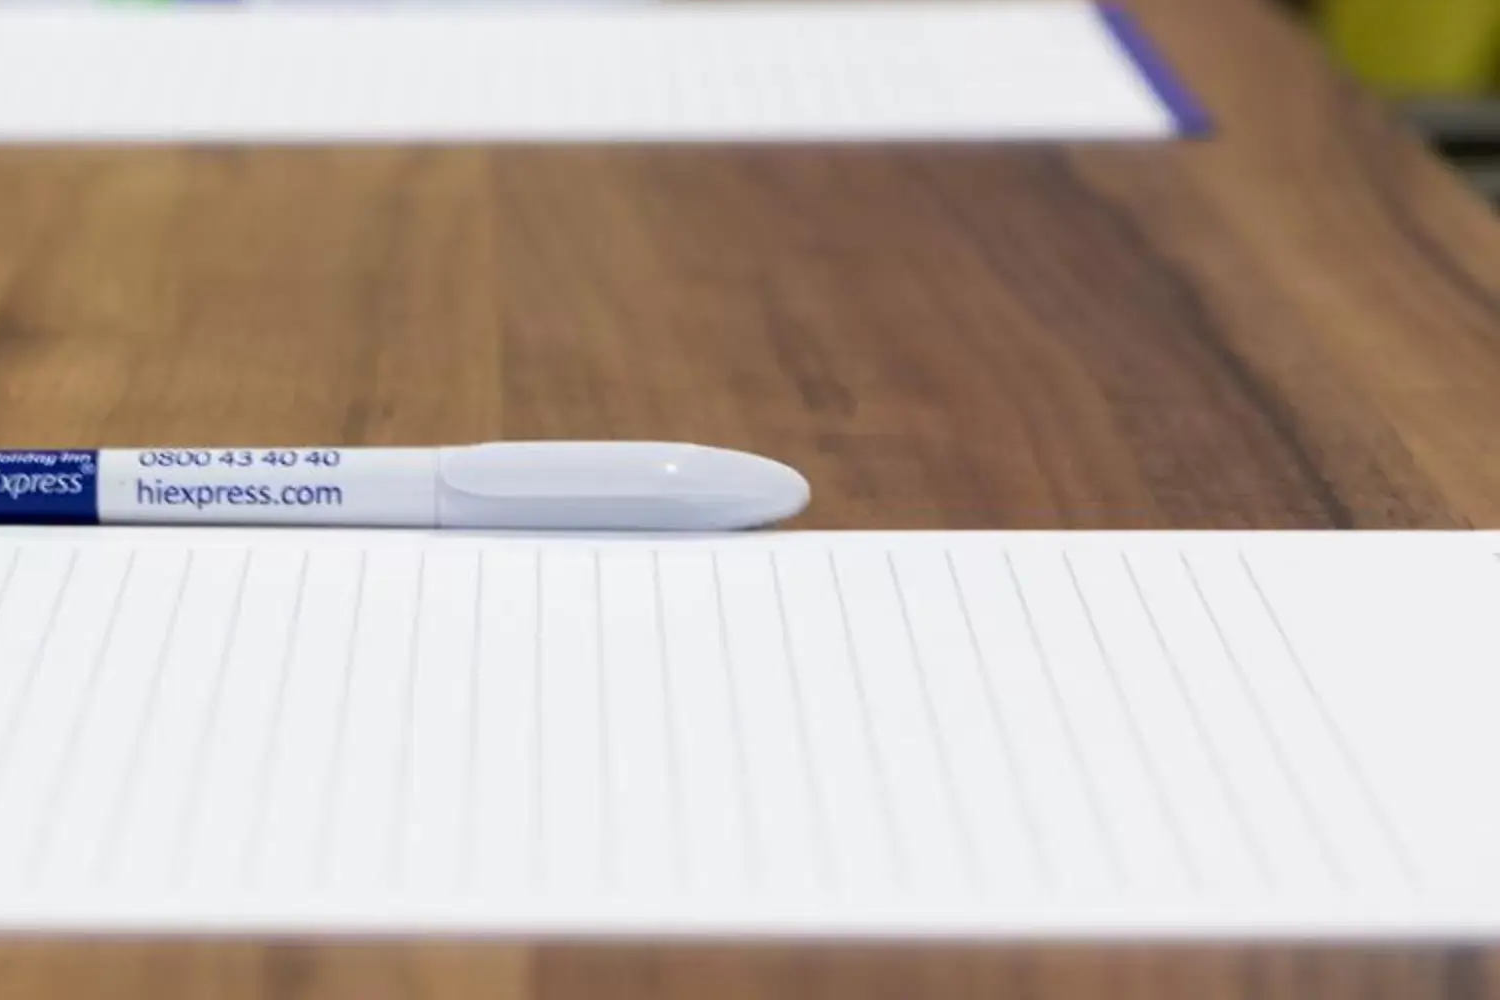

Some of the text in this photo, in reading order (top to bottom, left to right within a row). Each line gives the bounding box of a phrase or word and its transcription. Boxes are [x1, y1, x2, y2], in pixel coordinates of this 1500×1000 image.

[138, 450, 341, 467] 0800 43 40 40
[137, 479, 343, 509] hiexpress.com
